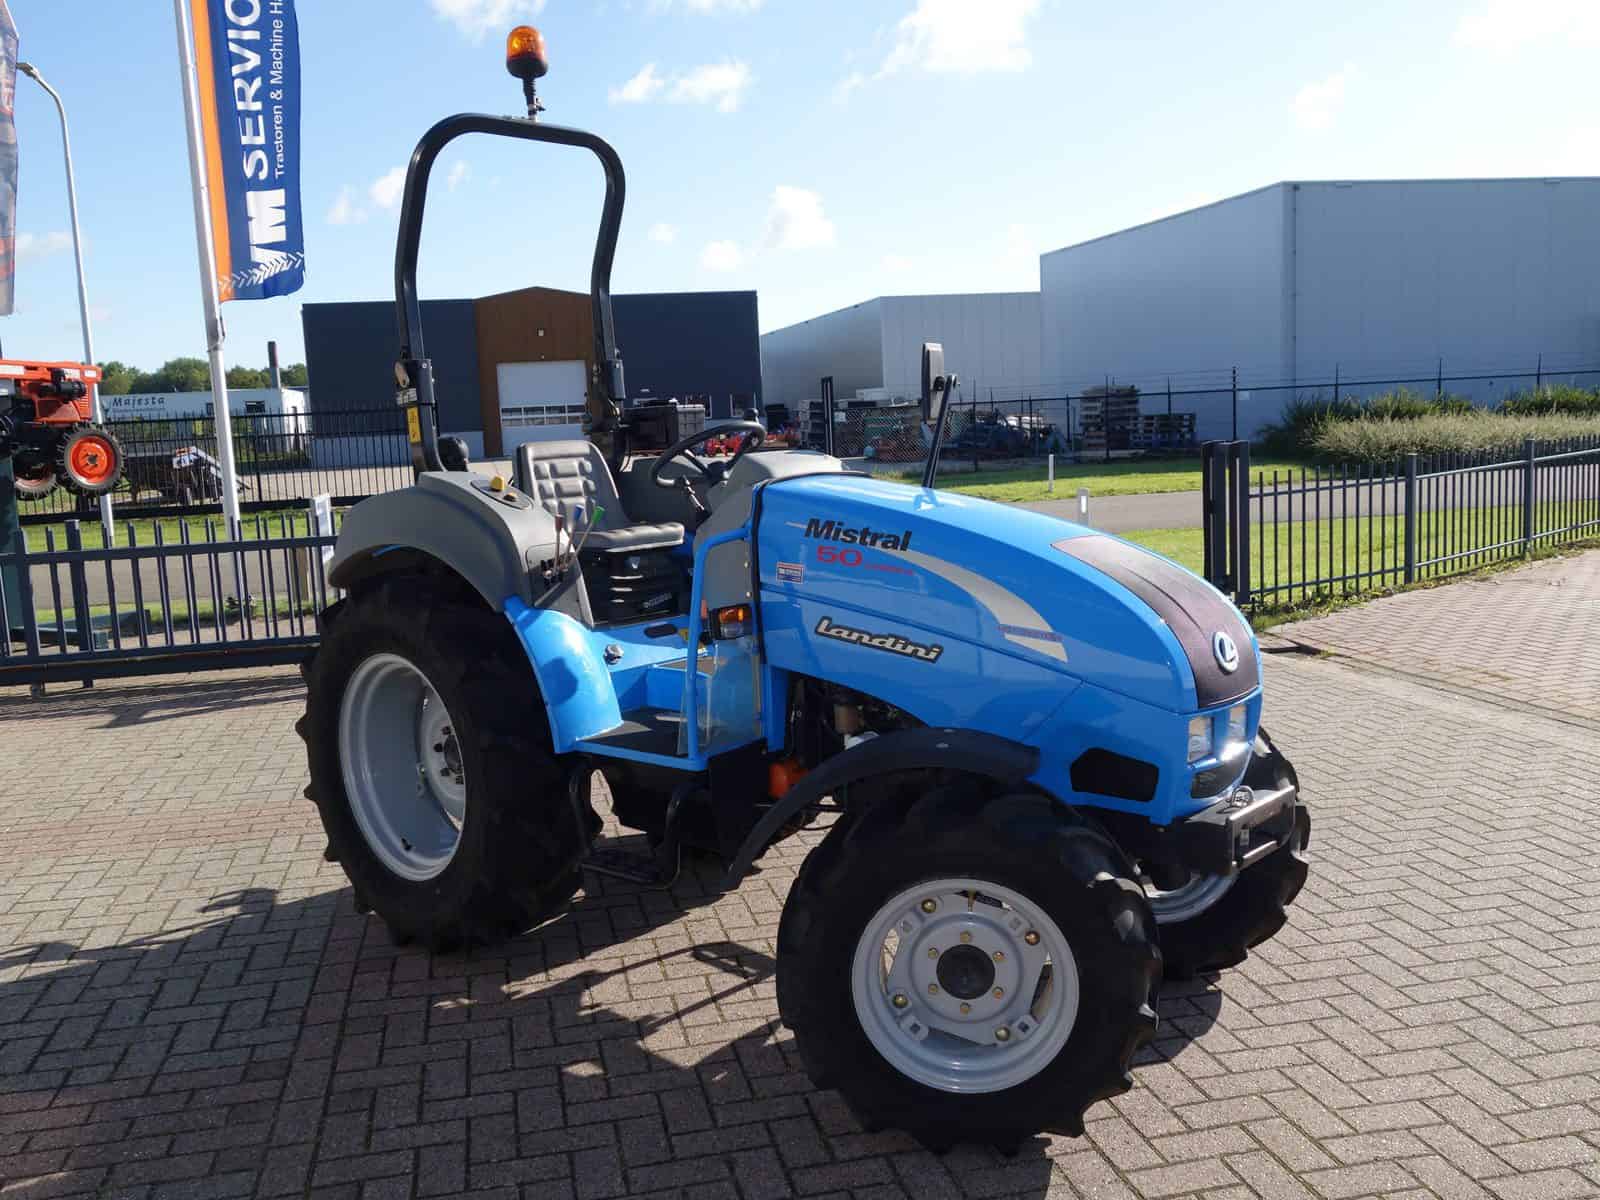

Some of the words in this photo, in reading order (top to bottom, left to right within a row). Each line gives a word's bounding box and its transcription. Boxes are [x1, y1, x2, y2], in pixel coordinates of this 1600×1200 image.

[268, 0, 284, 15] H
[268, 18, 284, 85] Machine
[269, 88, 284, 101] &
[272, 104, 285, 179] Tractoren
[111, 396, 166, 408] Majesta
[804, 517, 913, 552] Mistral
[816, 545, 863, 568] 50
[815, 616, 944, 663] Landini
